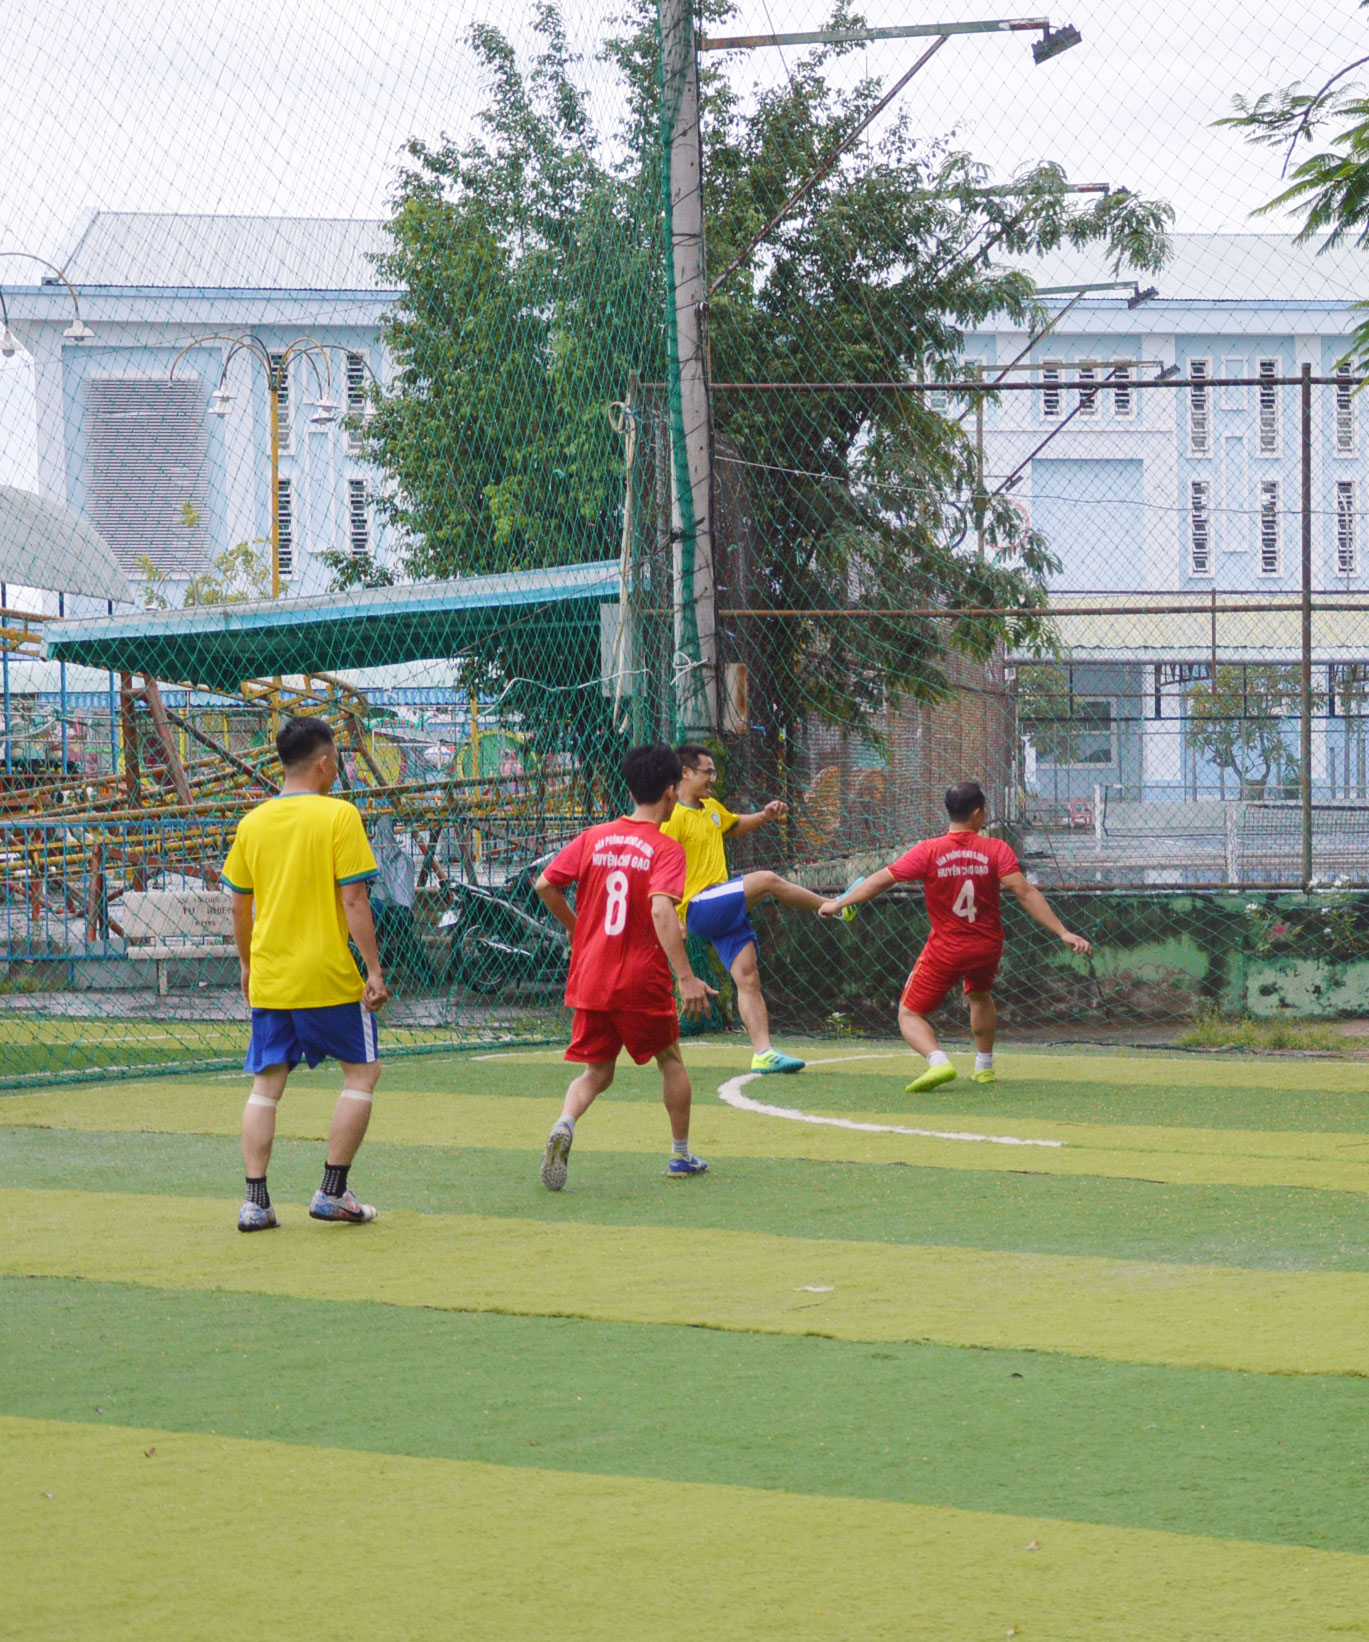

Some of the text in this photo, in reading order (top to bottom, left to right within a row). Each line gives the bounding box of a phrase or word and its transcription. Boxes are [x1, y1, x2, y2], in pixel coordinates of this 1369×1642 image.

[631, 855, 651, 872] GẠO
[604, 870, 629, 936] 8
[952, 879, 977, 924] 4
